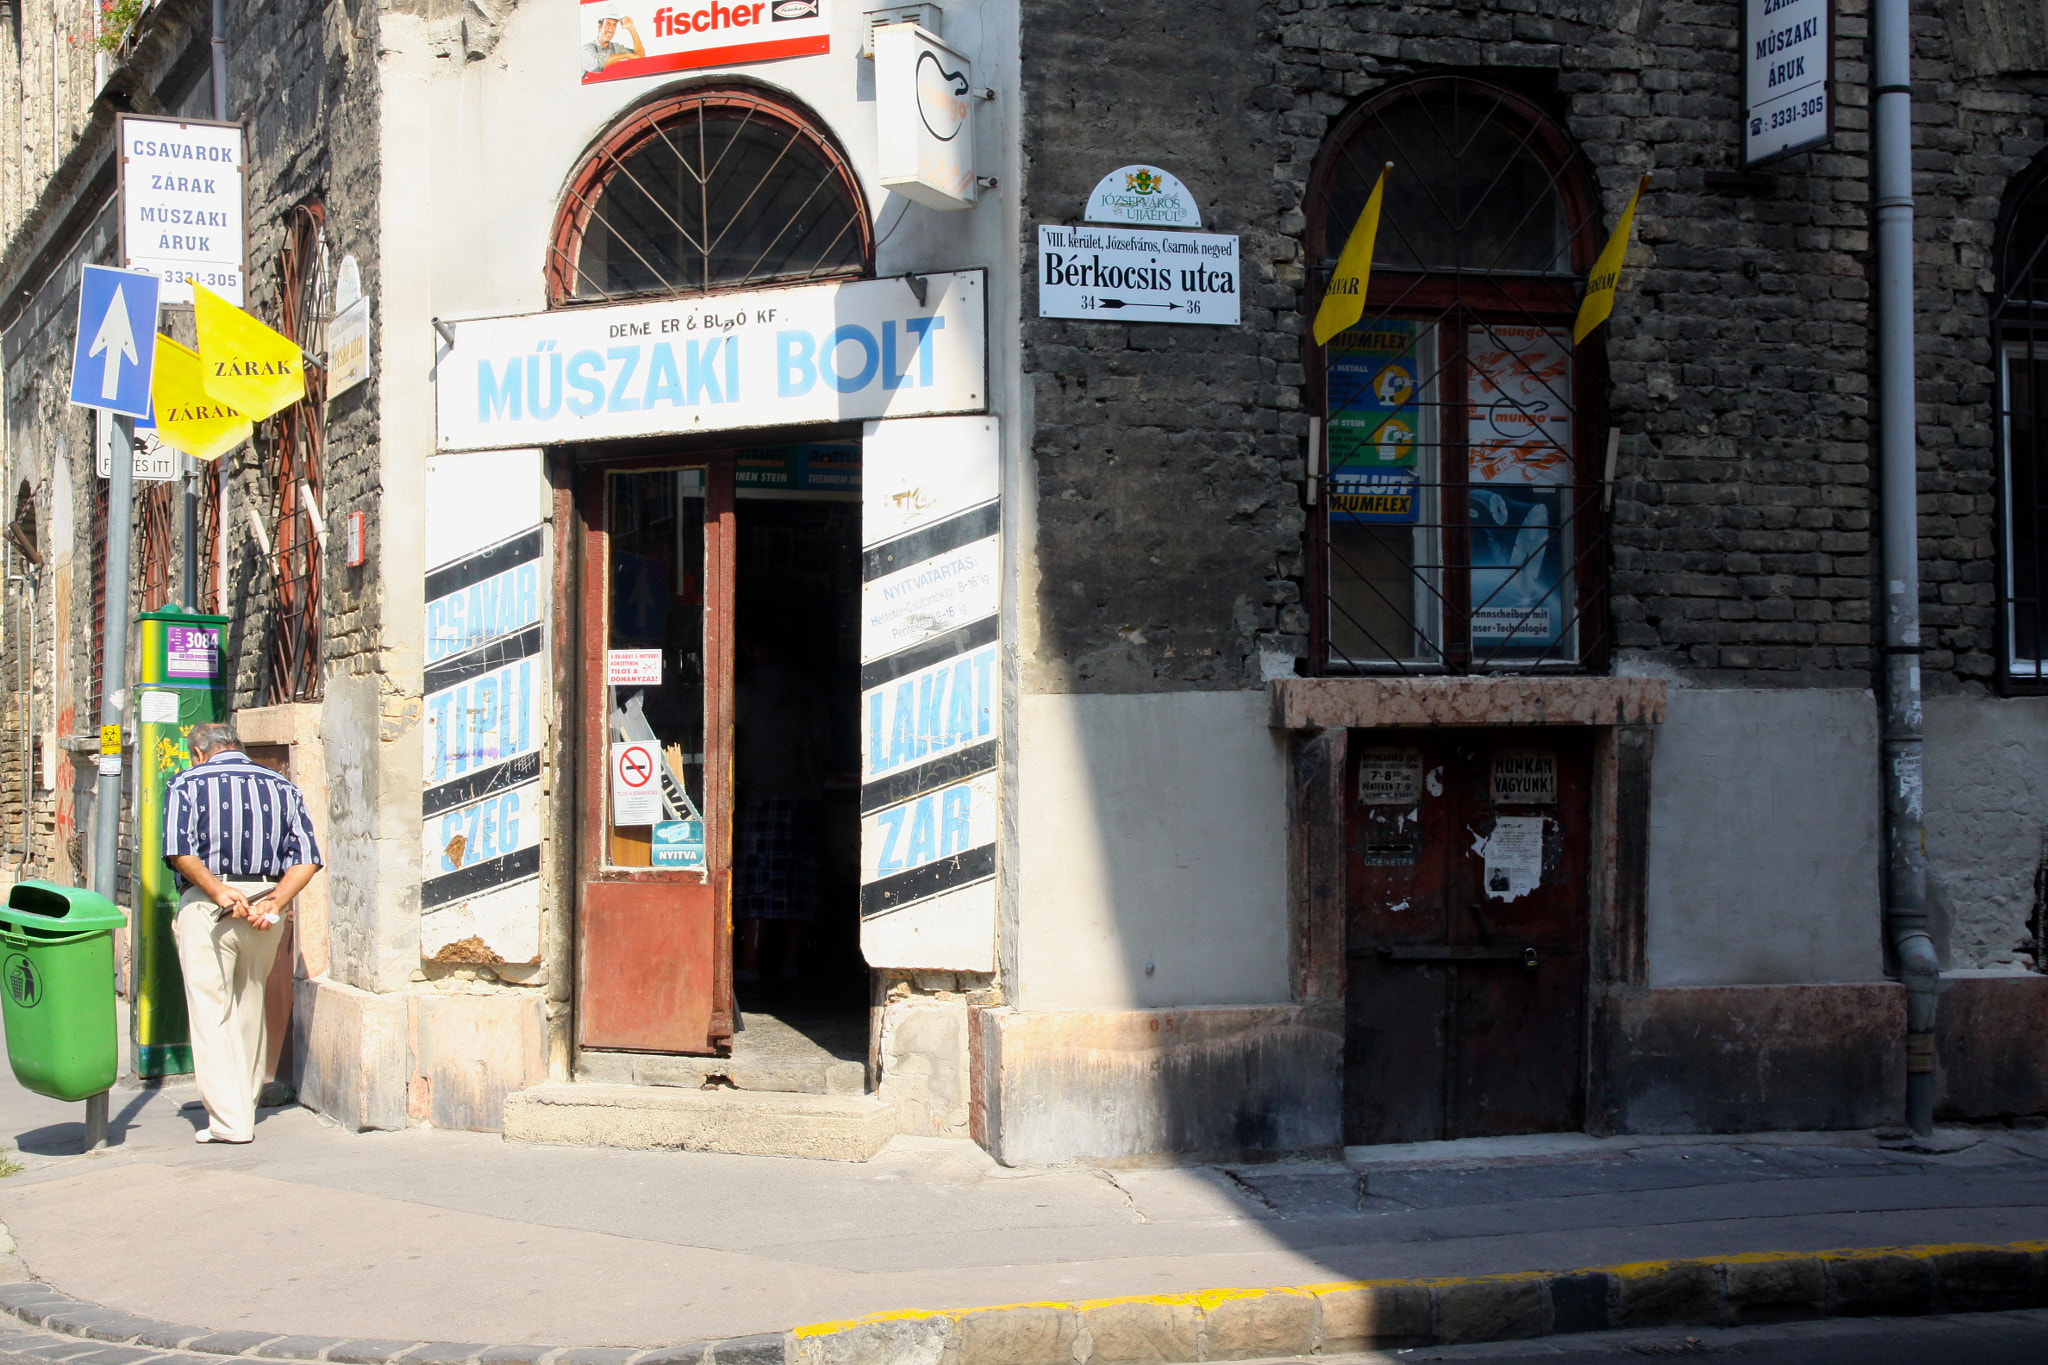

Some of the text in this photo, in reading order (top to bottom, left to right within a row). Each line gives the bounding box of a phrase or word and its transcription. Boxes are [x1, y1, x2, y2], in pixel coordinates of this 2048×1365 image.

[653, 0, 765, 38] fischer
[1769, 56, 1804, 88] ÁRUK
[1771, 96, 1823, 129] 3331-305
[133, 140, 233, 163] CSAVAROK
[152, 172, 216, 195] ZÁRAK
[159, 232, 211, 252] ÁRUK
[1047, 232, 1232, 258] VIII. kerület, Józsefváros, Csarnok negyed
[1045, 252, 1235, 293] Bérkocsis utca
[1081, 296, 1201, 314] 34 36
[686, 314, 699, 331] &
[1494, 328, 1545, 341] mungo
[215, 354, 292, 377] ZÁRAK
[477, 316, 945, 423] MŰSZAKI BOLT
[1337, 364, 1368, 372] METALL
[1495, 413, 1546, 427] mungo
[153, 461, 170, 473] ITT
[760, 472, 788, 482] STEIN
[428, 564, 536, 660] CSAVAR
[1532, 609, 1548, 619] mit
[186, 632, 219, 649] 3084
[430, 661, 530, 780] TIPLI
[870, 648, 995, 775] LAKAT
[1495, 776, 1553, 793] VAGYUNK!
[441, 793, 519, 872] SZEG
[659, 850, 698, 860] NYITVA
